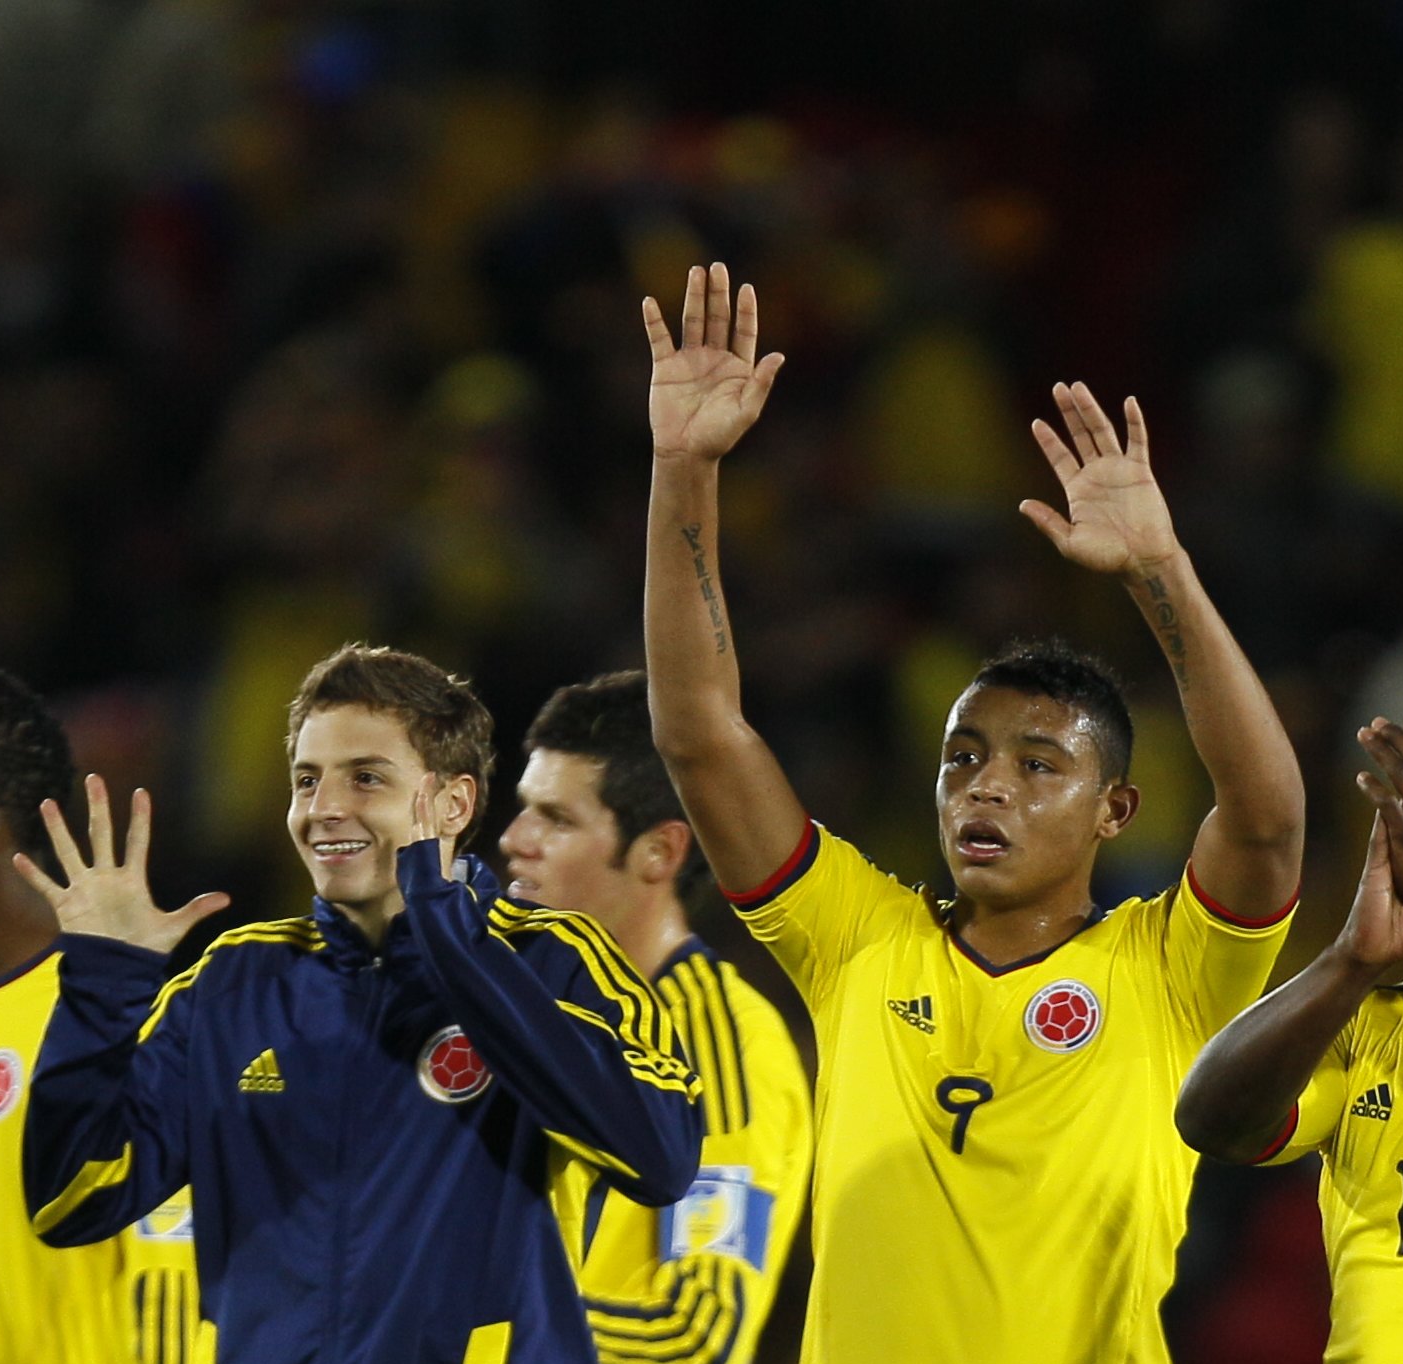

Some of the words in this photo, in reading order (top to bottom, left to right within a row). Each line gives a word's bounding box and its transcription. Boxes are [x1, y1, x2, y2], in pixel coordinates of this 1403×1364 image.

[887, 999, 937, 1035] adidas
[935, 1075, 994, 1155] 9
[1350, 1103, 1391, 1121] adida
